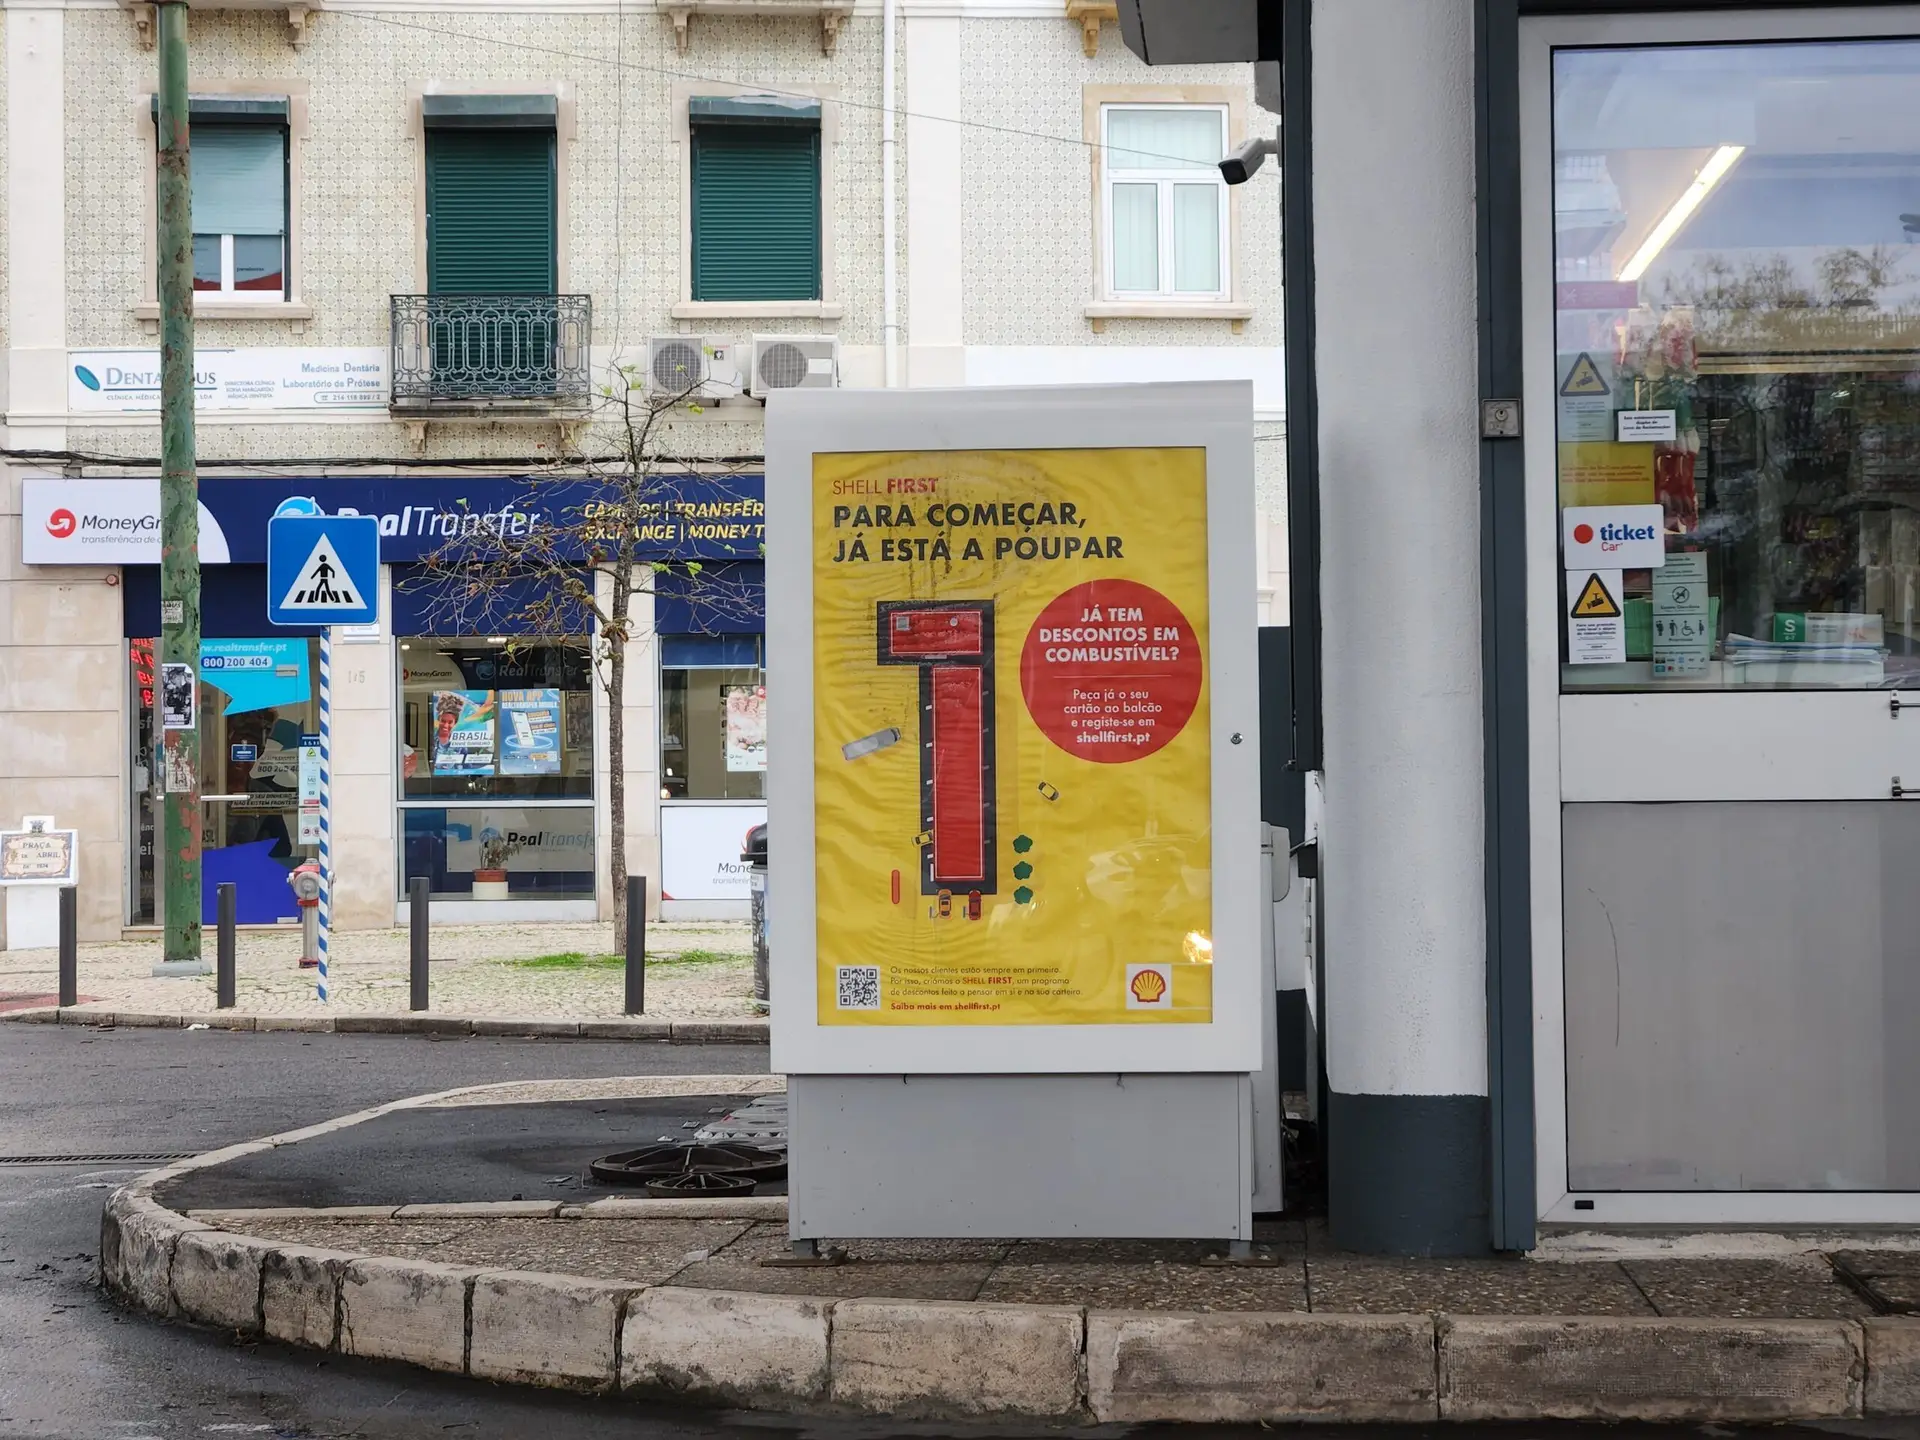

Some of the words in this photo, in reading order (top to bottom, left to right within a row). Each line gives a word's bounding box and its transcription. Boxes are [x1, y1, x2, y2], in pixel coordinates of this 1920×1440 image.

[302, 363, 340, 373] Medicina
[343, 362, 380, 372] Dentária
[106, 367, 216, 385] DENTAUS
[282, 378, 332, 388] Laboratório
[347, 377, 381, 388] Prótese
[106, 393, 134, 401] CLÍNICA
[832, 479, 882, 494] SHELL
[887, 477, 939, 493] FIRST
[675, 502, 764, 518] TRANSFER
[81, 514, 161, 533] MoneyGr
[337, 505, 541, 538] alTransfer
[833, 504, 915, 527] PARA
[927, 502, 1087, 535] COMEÇAR,
[689, 524, 749, 539] MONEY
[1600, 523, 1655, 541] ticket
[81, 535, 143, 544] transferência
[144, 536, 156, 544] de
[833, 531, 869, 562] JÁ
[881, 531, 951, 561] ESTÁ
[962, 538, 984, 560] A
[996, 536, 1124, 560] POUPAR
[1081, 604, 1103, 622] JÁ
[1108, 608, 1143, 621] TEM
[1784, 619, 1796, 633] S
[1040, 627, 1147, 642] DESCONTOS
[1153, 627, 1179, 640] EM
[200, 642, 287, 654] w.realtransfer.pt
[1045, 643, 1180, 662] COMBUSTÍVEL?
[203, 658, 223, 667] 800
[227, 658, 245, 667] 200
[249, 657, 268, 666] 404
[410, 670, 453, 679] MoneyGram
[499, 663, 578, 678] RealTransfer
[1073, 689, 1099, 702] Peça
[1103, 689, 1115, 702] já
[1064, 703, 1101, 713] cartão
[1123, 702, 1162, 713] balcão
[1082, 717, 1134, 730] registe-se
[452, 732, 489, 741] BRASIL
[1077, 731, 1150, 745] shellfirst.pt
[22, 842, 51, 850] PRAÇA
[507, 831, 593, 849] RealTransf
[717, 862, 752, 874] Mone
[905, 978, 921, 986] isso,
[988, 977, 1014, 985] FIRST,
[955, 1002, 1000, 1011] shellfirst.pt
